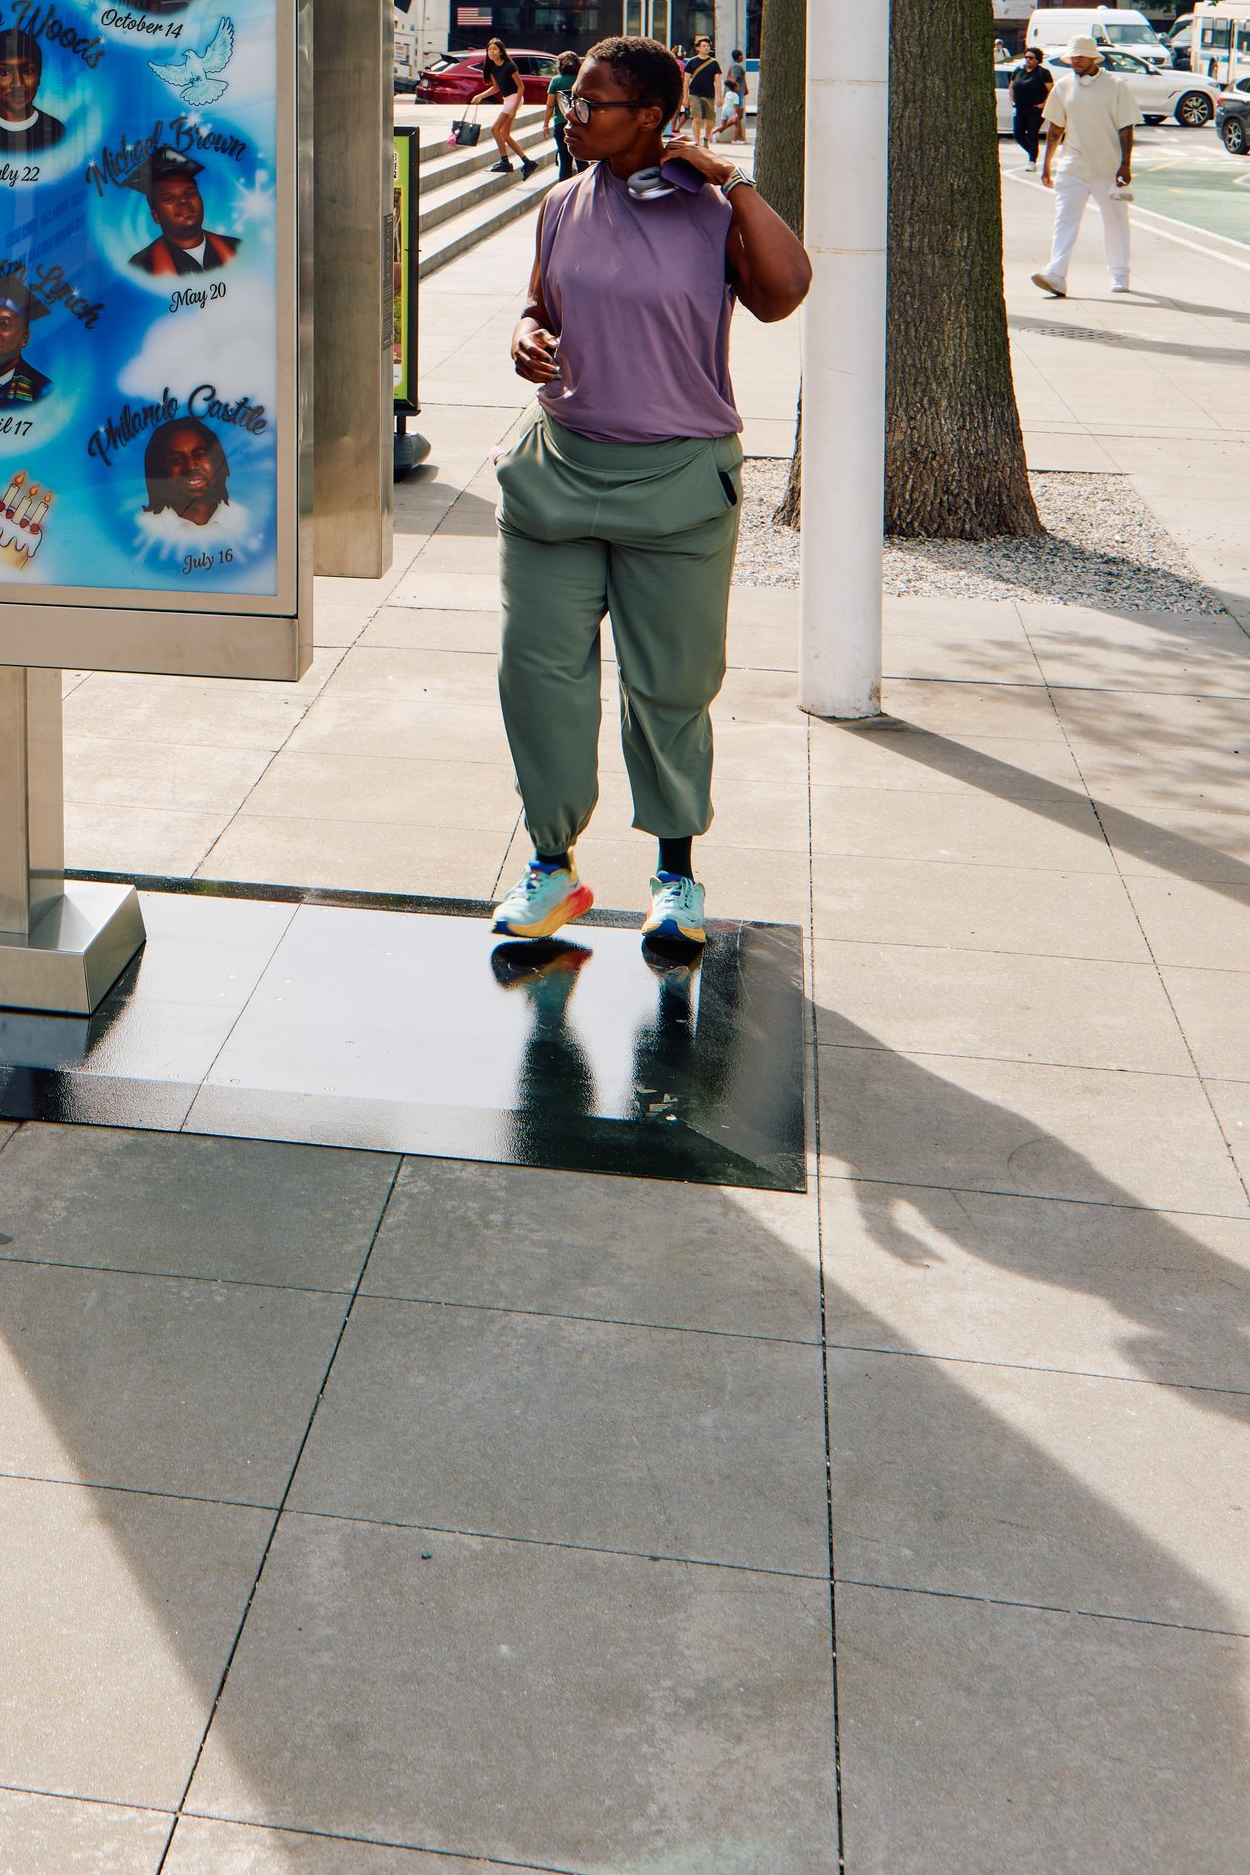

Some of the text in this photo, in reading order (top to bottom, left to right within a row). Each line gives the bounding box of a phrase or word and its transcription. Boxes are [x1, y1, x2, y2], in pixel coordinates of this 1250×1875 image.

[12, 0, 105, 68] Woods
[101, 9, 183, 39] October 14
[86, 117, 247, 198] Michael Brown
[21, 166, 40, 182] 22
[30, 263, 105, 330] Lynch
[169, 282, 226, 313] May 20
[15, 421, 33, 436] 17
[88, 384, 268, 467] Philando Castile
[183, 549, 233, 575] July 16
